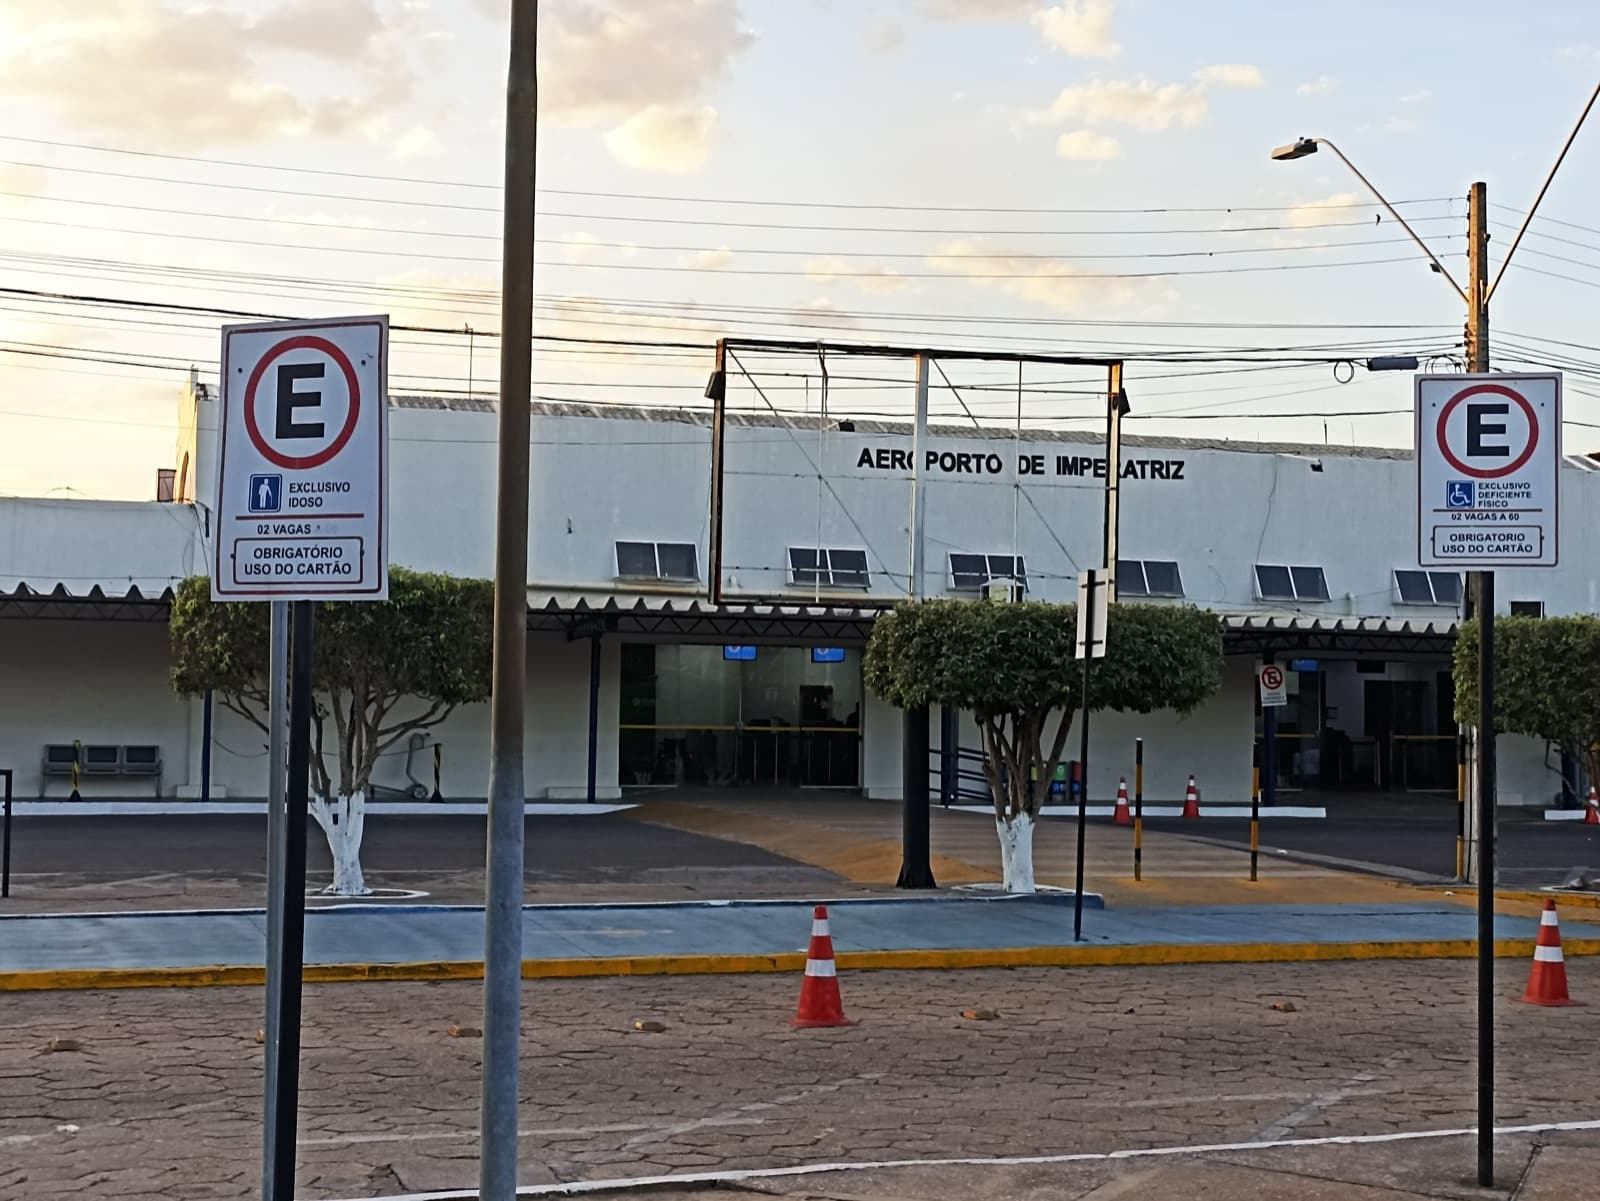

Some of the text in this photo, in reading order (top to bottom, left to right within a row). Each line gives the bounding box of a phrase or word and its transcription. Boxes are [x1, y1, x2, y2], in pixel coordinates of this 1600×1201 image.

[275, 362, 325, 439] E
[1466, 403, 1510, 457] E
[1018, 455, 1045, 475] DE
[1056, 456, 1184, 480] IMPEATRIZ
[289, 482, 351, 493] EXCLUSIVO
[1478, 482, 1531, 490] EXCLUSIVO
[1478, 491, 1532, 499] DEFICIENTE
[288, 497, 323, 508] IDOSO
[1465, 513, 1497, 521] VAGAS
[257, 524, 270, 535] 02
[273, 524, 311, 535] VAGAS
[253, 545, 343, 559] OBRIGATÓRIO
[1442, 543, 1533, 553] USO DO CARTÃO
[244, 560, 352, 576] USO DO CARTÃO
